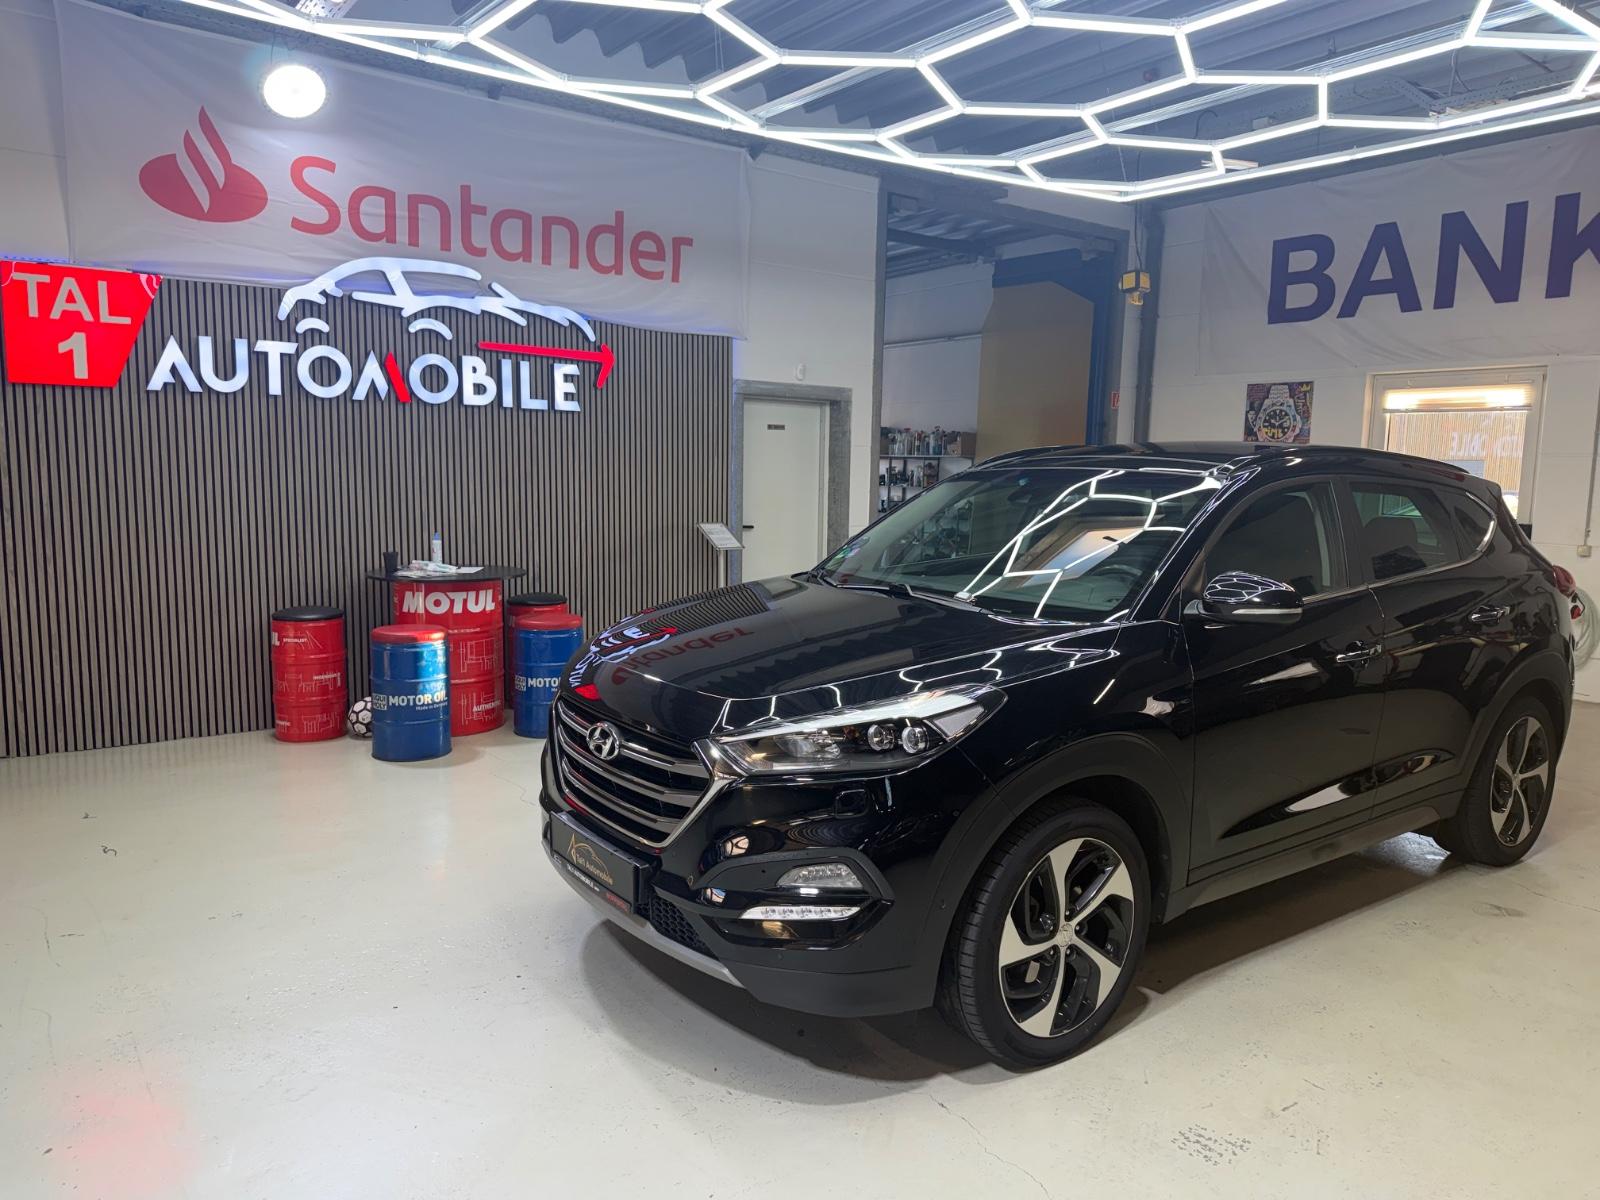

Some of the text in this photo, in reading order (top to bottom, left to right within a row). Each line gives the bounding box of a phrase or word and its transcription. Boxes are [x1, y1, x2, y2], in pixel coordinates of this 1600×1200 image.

[290, 155, 695, 284] Santander
[1267, 191, 1600, 325] BANK
[12, 271, 132, 325] TAL
[58, 331, 89, 380] 1
[146, 334, 582, 413] AUTOMOBILE
[402, 588, 496, 615] MOTUL
[388, 689, 448, 706] MOTOR OIL
[527, 677, 561, 688] MOTO
